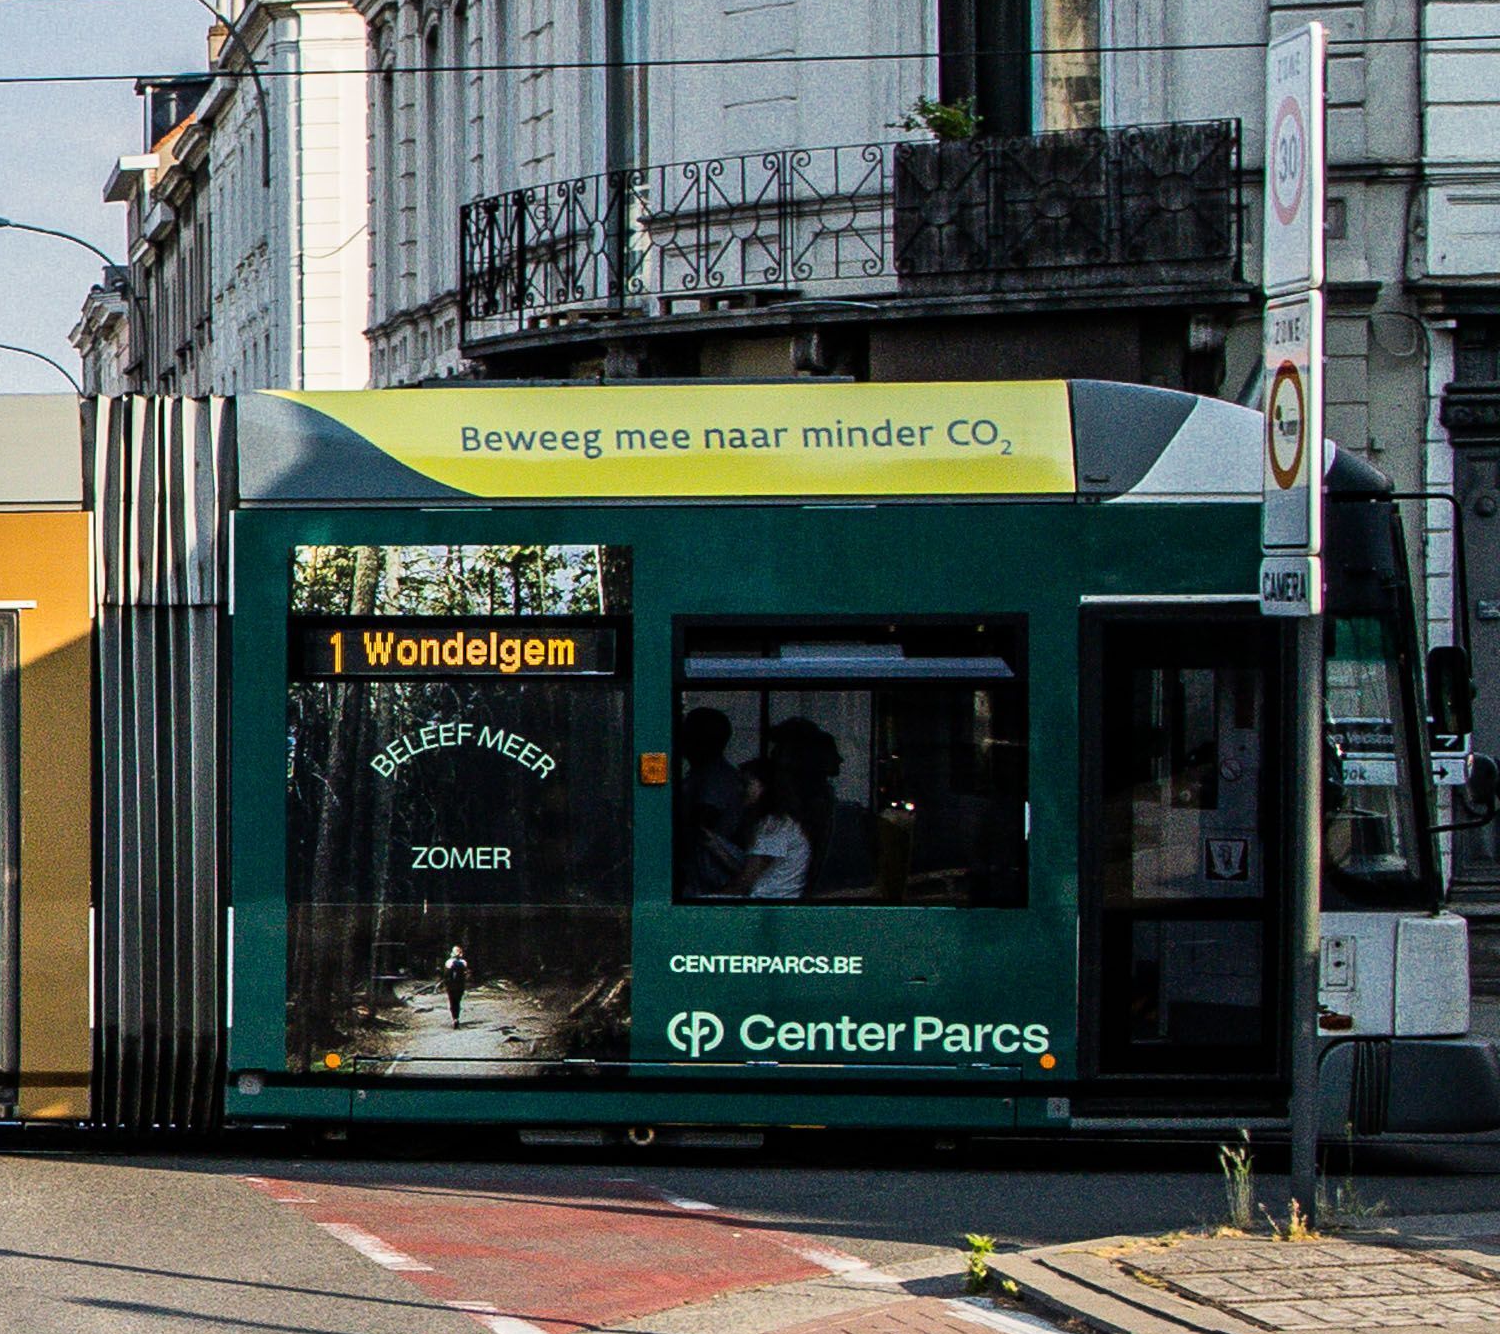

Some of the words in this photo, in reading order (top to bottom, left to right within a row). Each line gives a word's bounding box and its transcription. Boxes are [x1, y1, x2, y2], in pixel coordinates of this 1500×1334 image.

[461, 426, 602, 459] Beweeg
[615, 430, 690, 450] mee
[704, 428, 788, 450] naar
[803, 420, 934, 449] minder
[330, 632, 343, 673] 1
[363, 632, 575, 673] Wondelgem
[370, 723, 473, 778] BELEEF
[477, 726, 556, 780] MEER
[411, 847, 512, 869] ZOMER
[669, 955, 863, 974] CENTERPARCS.BE
[739, 1014, 907, 1052] Center
[913, 1015, 1049, 1054] Parcs
